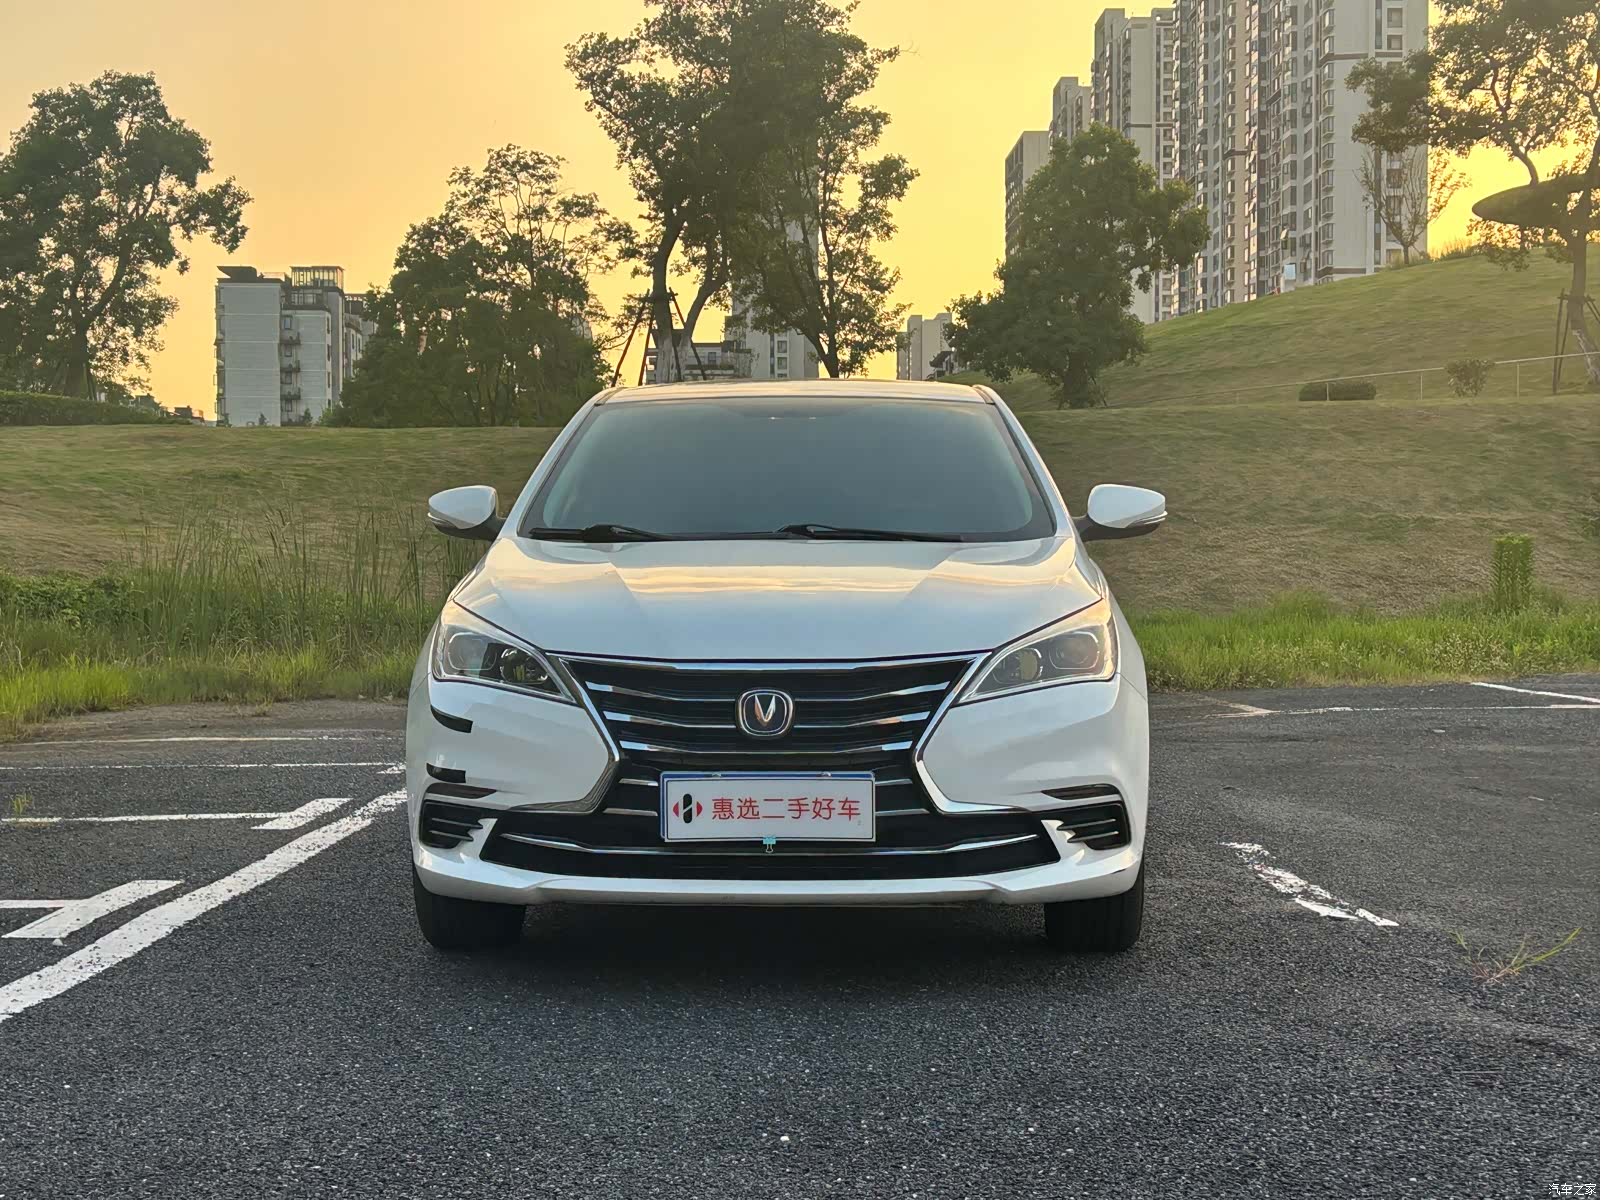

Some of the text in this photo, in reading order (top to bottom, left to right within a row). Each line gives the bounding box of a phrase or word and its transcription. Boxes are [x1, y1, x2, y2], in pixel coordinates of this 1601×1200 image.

[711, 797, 861, 821] 惠选二手好车
